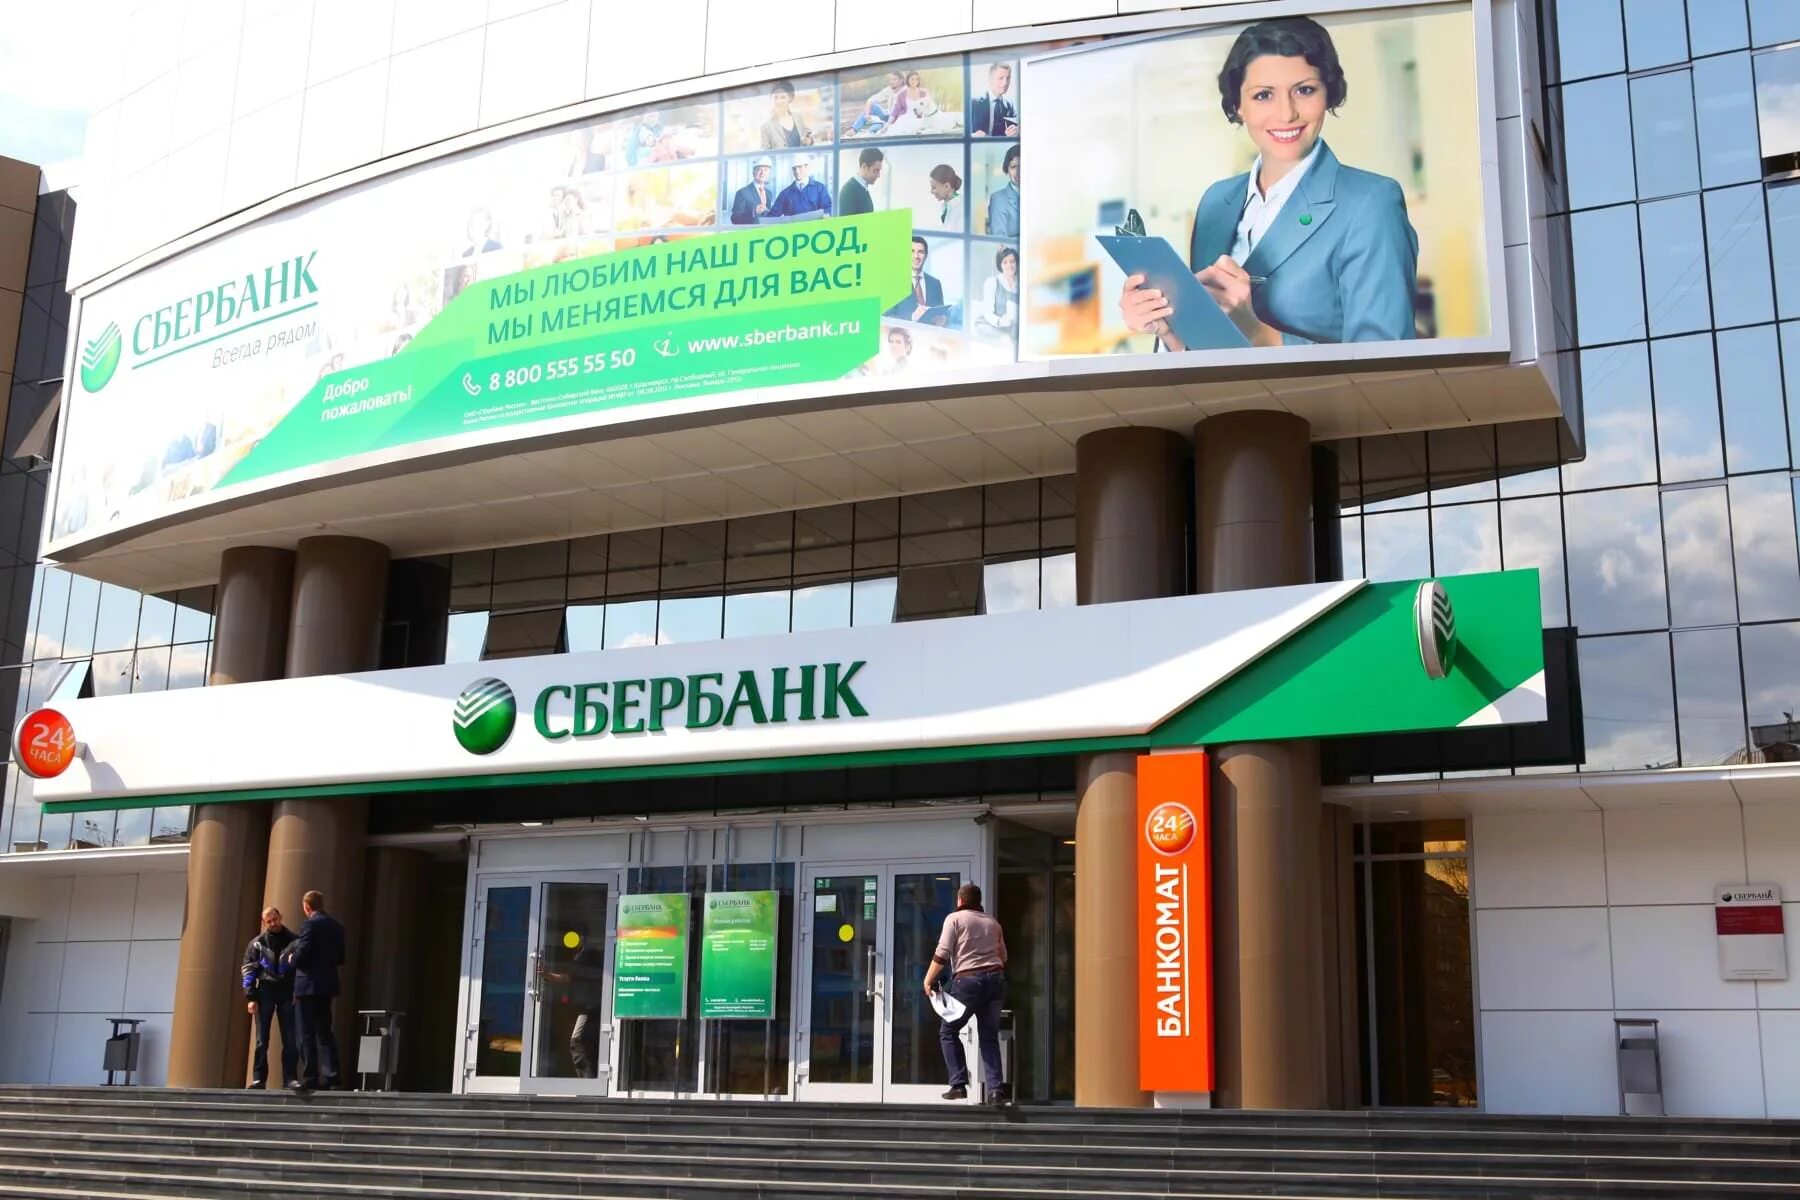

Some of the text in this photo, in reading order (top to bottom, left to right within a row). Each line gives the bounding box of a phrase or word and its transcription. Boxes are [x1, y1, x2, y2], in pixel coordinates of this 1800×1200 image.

[489, 225, 869, 311] МЫ ЛЮБИМ НАШ ГОРОД,
[132, 250, 319, 356] СБЕРБАНК
[487, 263, 863, 345] МЫ МЕНЯЕМСЯ ДЛЯ ВАС!
[212, 321, 317, 369] Всегда рядом
[688, 319, 861, 354] www.sberbank.ru
[322, 378, 370, 404] Добро
[488, 347, 636, 391] 8 800 555 55 50
[321, 384, 414, 424] пожаловать!
[534, 660, 869, 739] СБЕРБАНК
[30, 748, 62, 764] ЧАСА
[31, 722, 65, 751] 24
[1153, 814, 1177, 833] 24
[1155, 862, 1182, 1037] БАНКОМАТ
